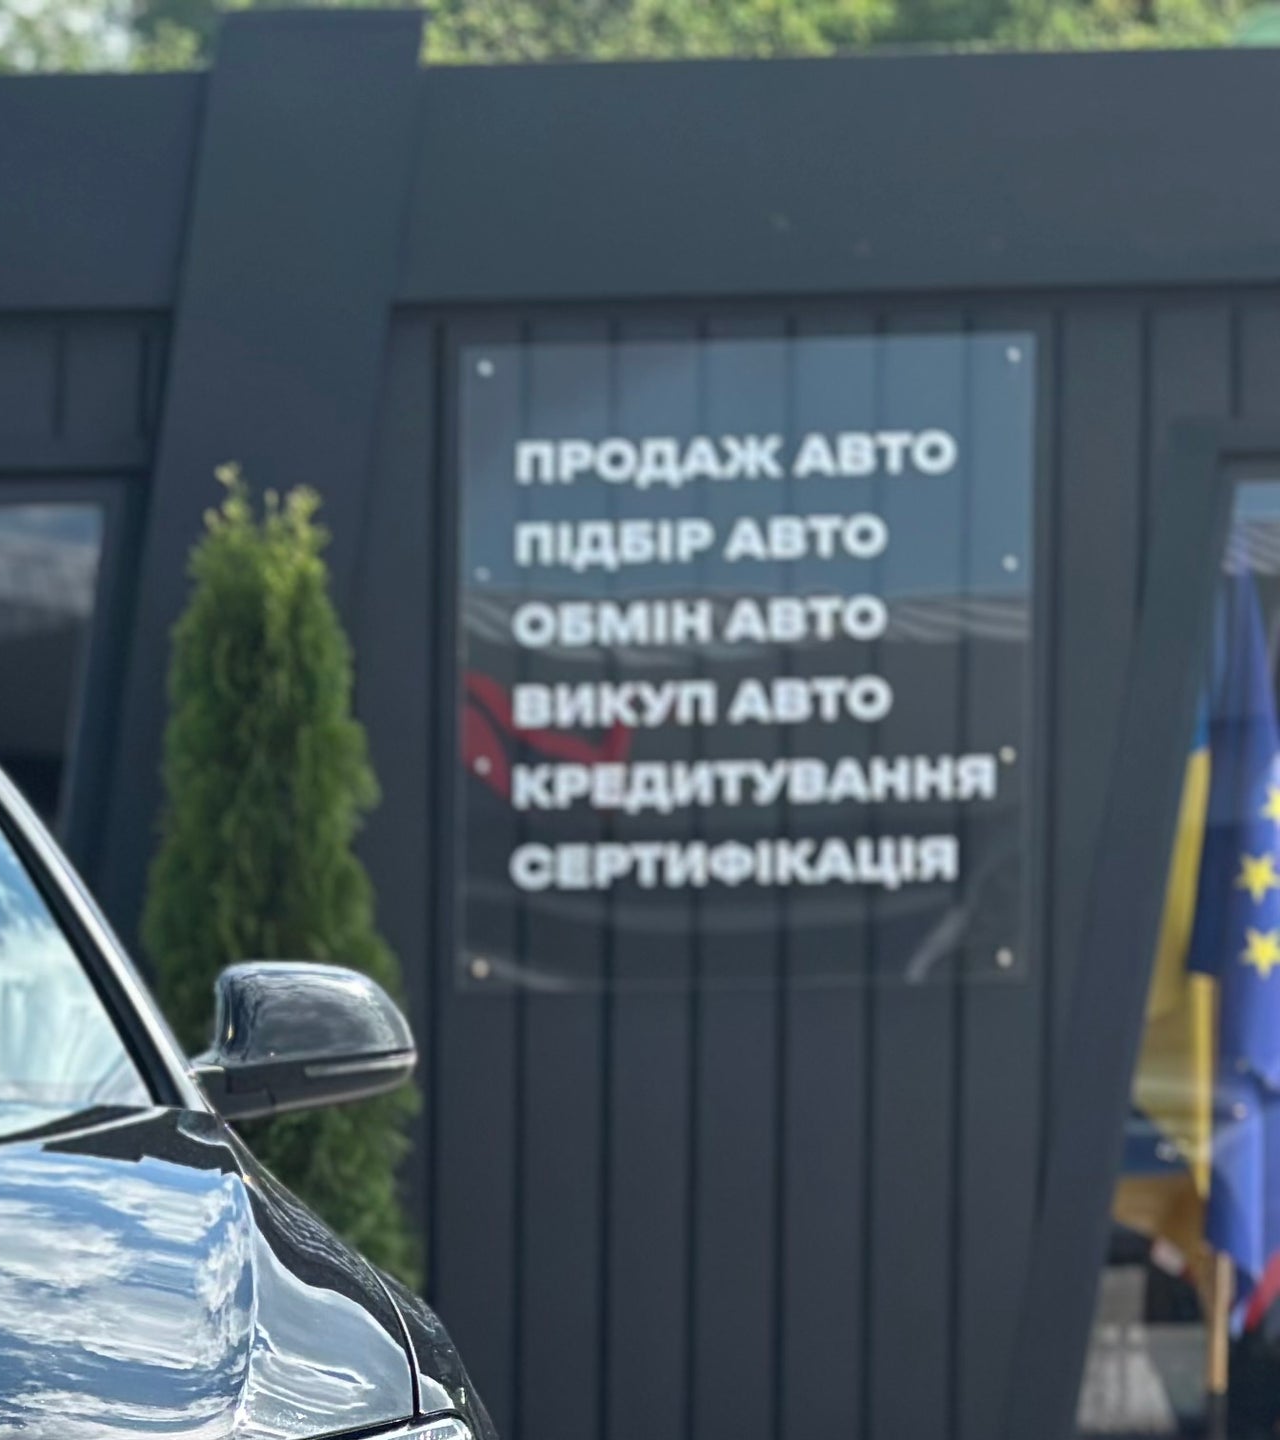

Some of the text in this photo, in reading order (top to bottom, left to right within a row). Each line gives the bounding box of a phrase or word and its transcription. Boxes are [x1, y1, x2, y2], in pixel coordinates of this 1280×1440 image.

[513, 429, 960, 489] ПРОДАЖ АВТО
[512, 513, 890, 570] ПІДБІР АВТО
[512, 595, 890, 648] ОБМІН АВТО
[512, 677, 894, 729] ВИКУП АВТО
[510, 752, 998, 815] КРЕДИТУВАННЯ
[509, 834, 961, 892] СЕРТИФІКАЦІЯ
